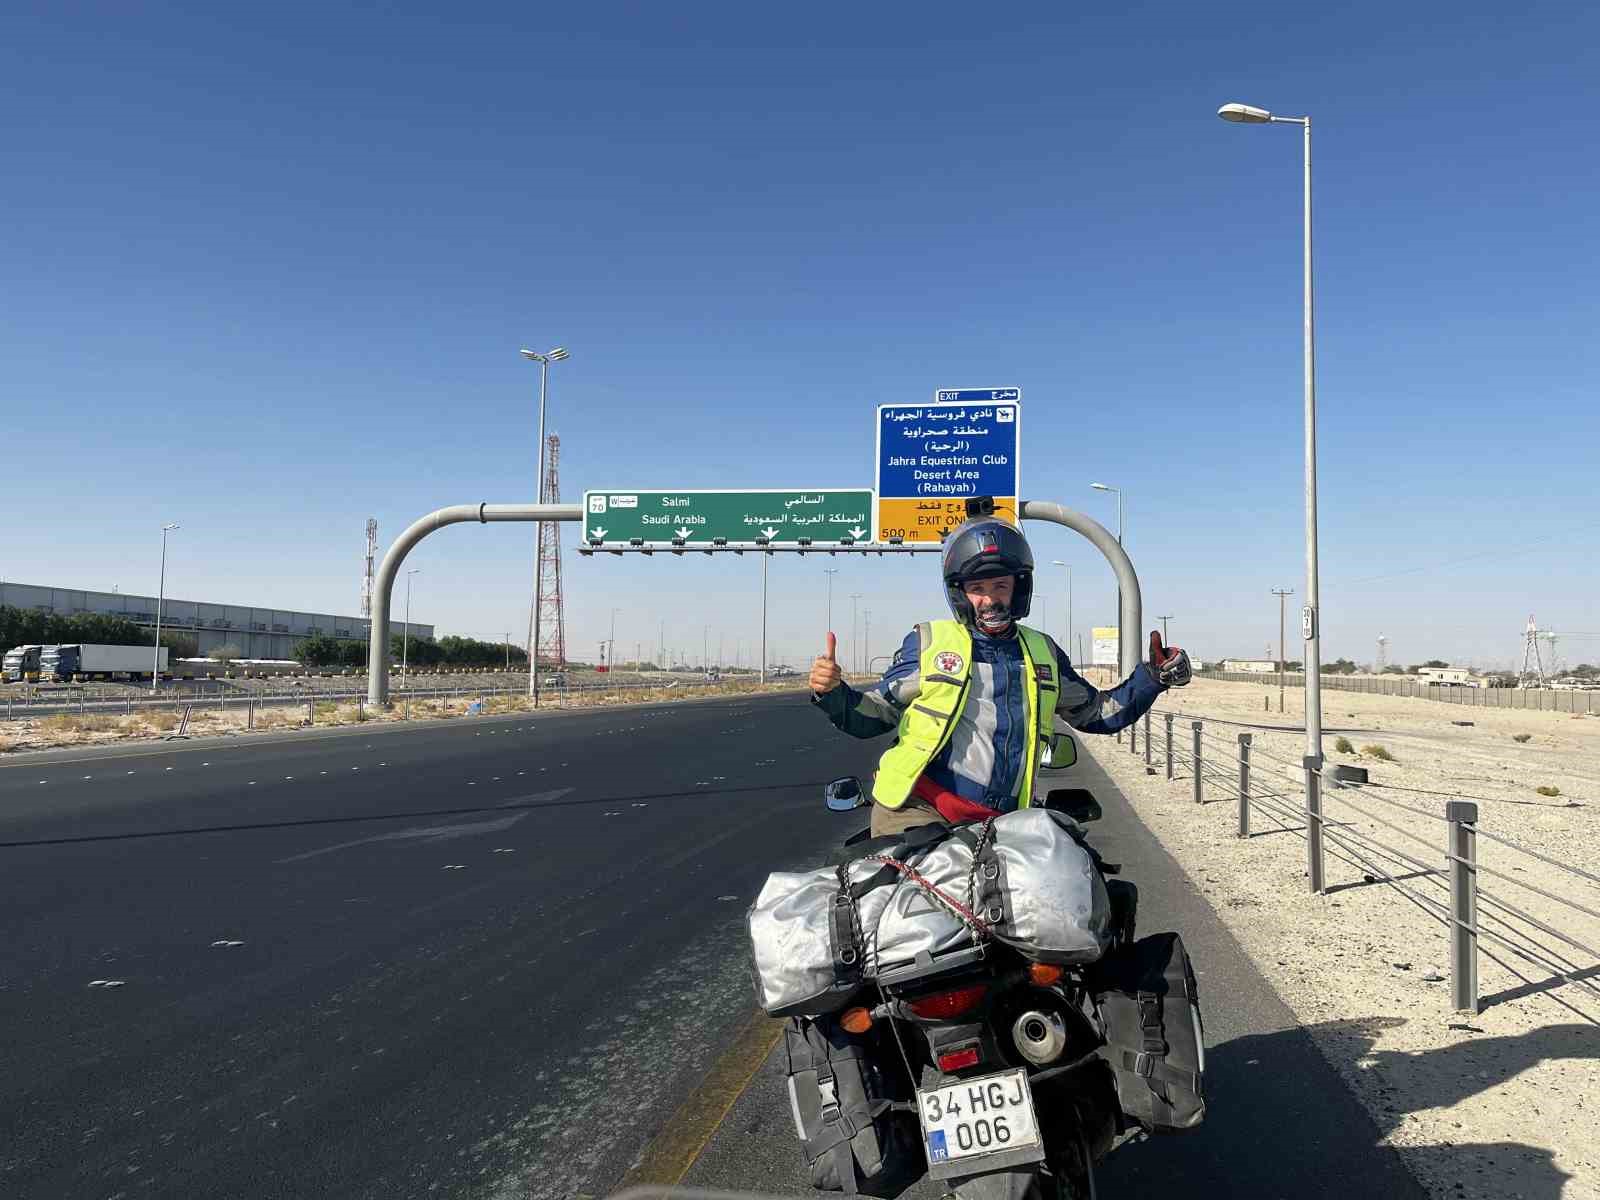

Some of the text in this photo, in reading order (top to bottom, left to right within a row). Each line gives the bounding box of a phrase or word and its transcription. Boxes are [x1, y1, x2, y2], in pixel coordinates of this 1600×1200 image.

[940, 392, 960, 401] EXIT
[991, 391, 1017, 400] مخرج
[885, 408, 993, 422] نادي فروسية الجهراء
[903, 425, 989, 438] منطقة صحراوية
[888, 454, 1008, 467] Jahra Equestrian Club
[914, 469, 980, 480] Desert Area
[917, 482, 976, 494] (Rahayah)
[662, 496, 690, 507] Salmi
[784, 495, 824, 509] السالمي
[591, 503, 604, 512] 70
[642, 514, 706, 524] Saudi Arabia
[743, 513, 865, 525] المملكة العربية السعودية
[918, 515, 941, 525] EXIT
[882, 528, 919, 538] 500 m
[926, 1078, 1024, 1122] 34 HGJ
[956, 1115, 1011, 1151] 006
[933, 1148, 948, 1159] TR
